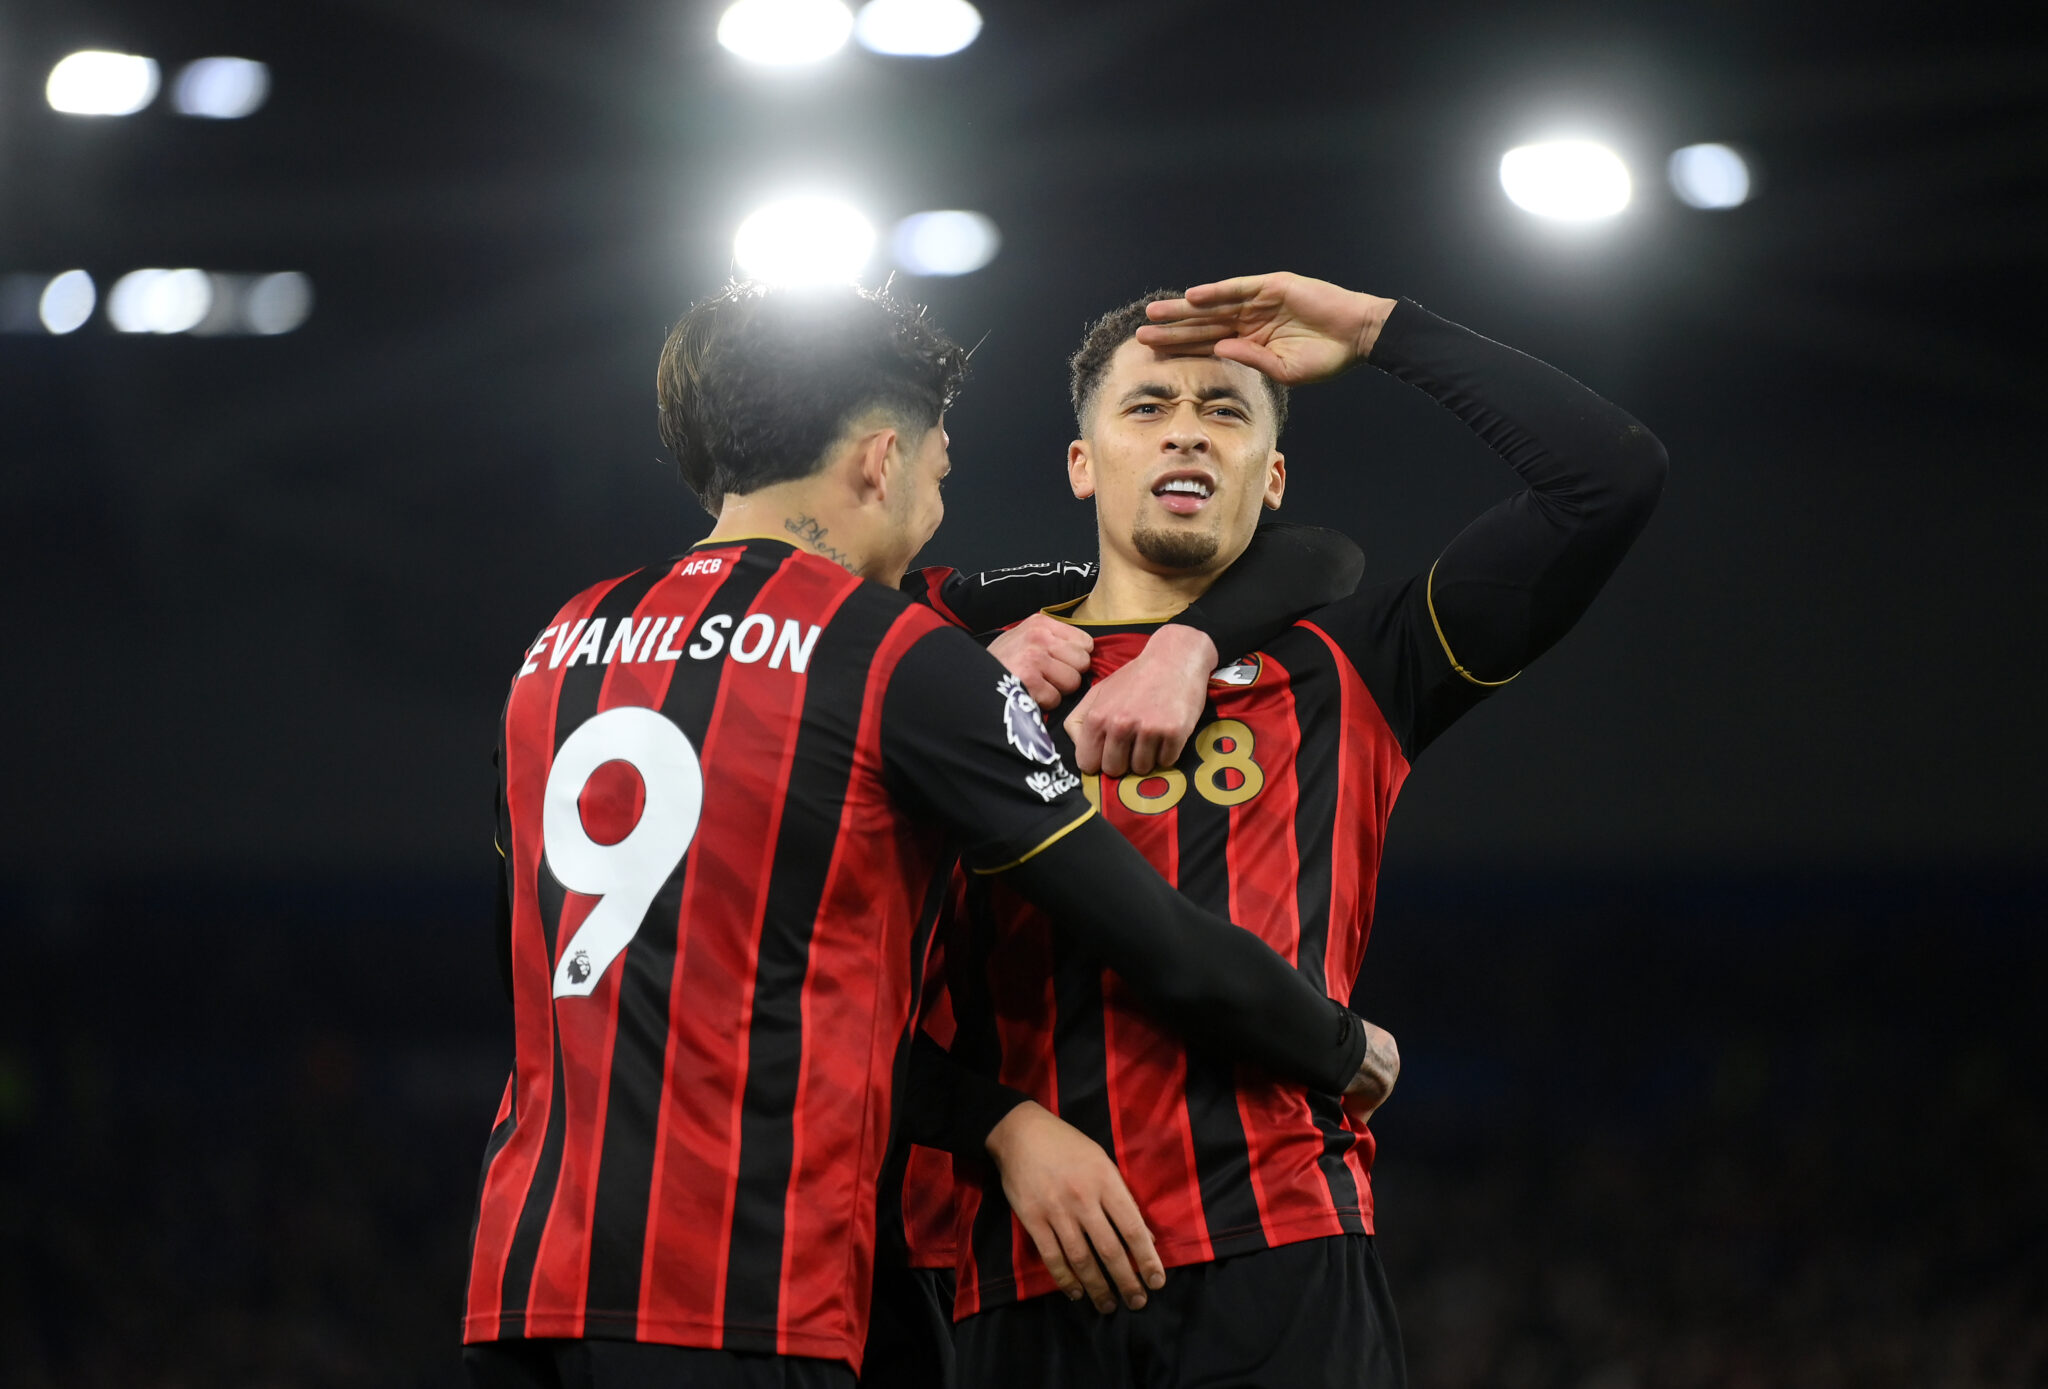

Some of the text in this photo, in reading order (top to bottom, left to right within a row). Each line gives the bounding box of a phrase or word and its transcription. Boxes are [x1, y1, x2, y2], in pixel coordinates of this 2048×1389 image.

[681, 558, 723, 577] AFCB
[518, 613, 822, 678] EVANILSON
[543, 706, 704, 1000] 9
